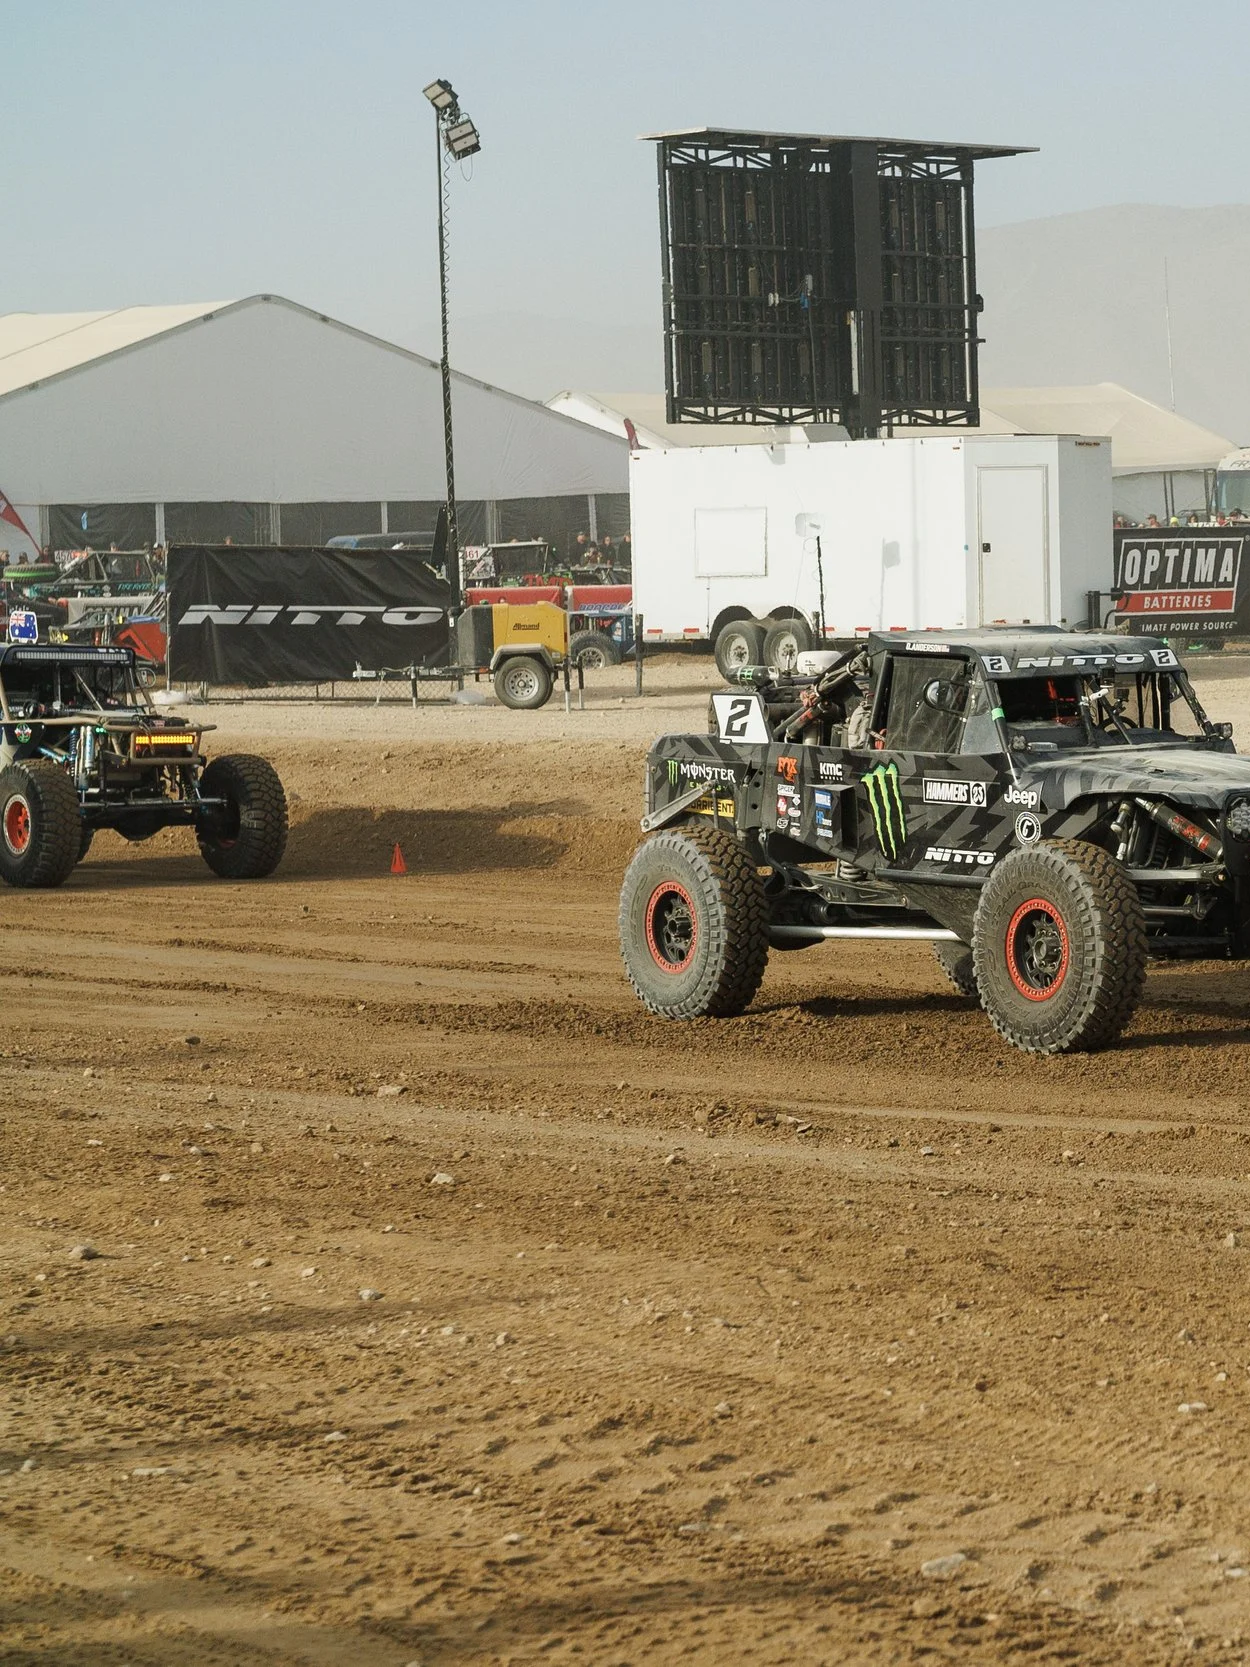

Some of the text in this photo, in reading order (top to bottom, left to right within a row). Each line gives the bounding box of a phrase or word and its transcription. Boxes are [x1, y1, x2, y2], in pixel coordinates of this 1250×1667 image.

[1124, 547, 1234, 586] OPTIMA
[1143, 594, 1212, 609] BATTERIES
[178, 604, 443, 626] NITTO
[512, 622, 540, 631] Allmand
[1170, 622, 1199, 632] POWER
[1203, 620, 1234, 631] SOURCE
[990, 650, 1171, 671] 2 NITTO 2
[725, 699, 752, 737] 2
[680, 761, 736, 783] MONSTER
[778, 757, 798, 782] FOX
[926, 782, 969, 802] HAMMERS
[1004, 784, 1038, 808] Jeep
[924, 847, 995, 865] NITTO
